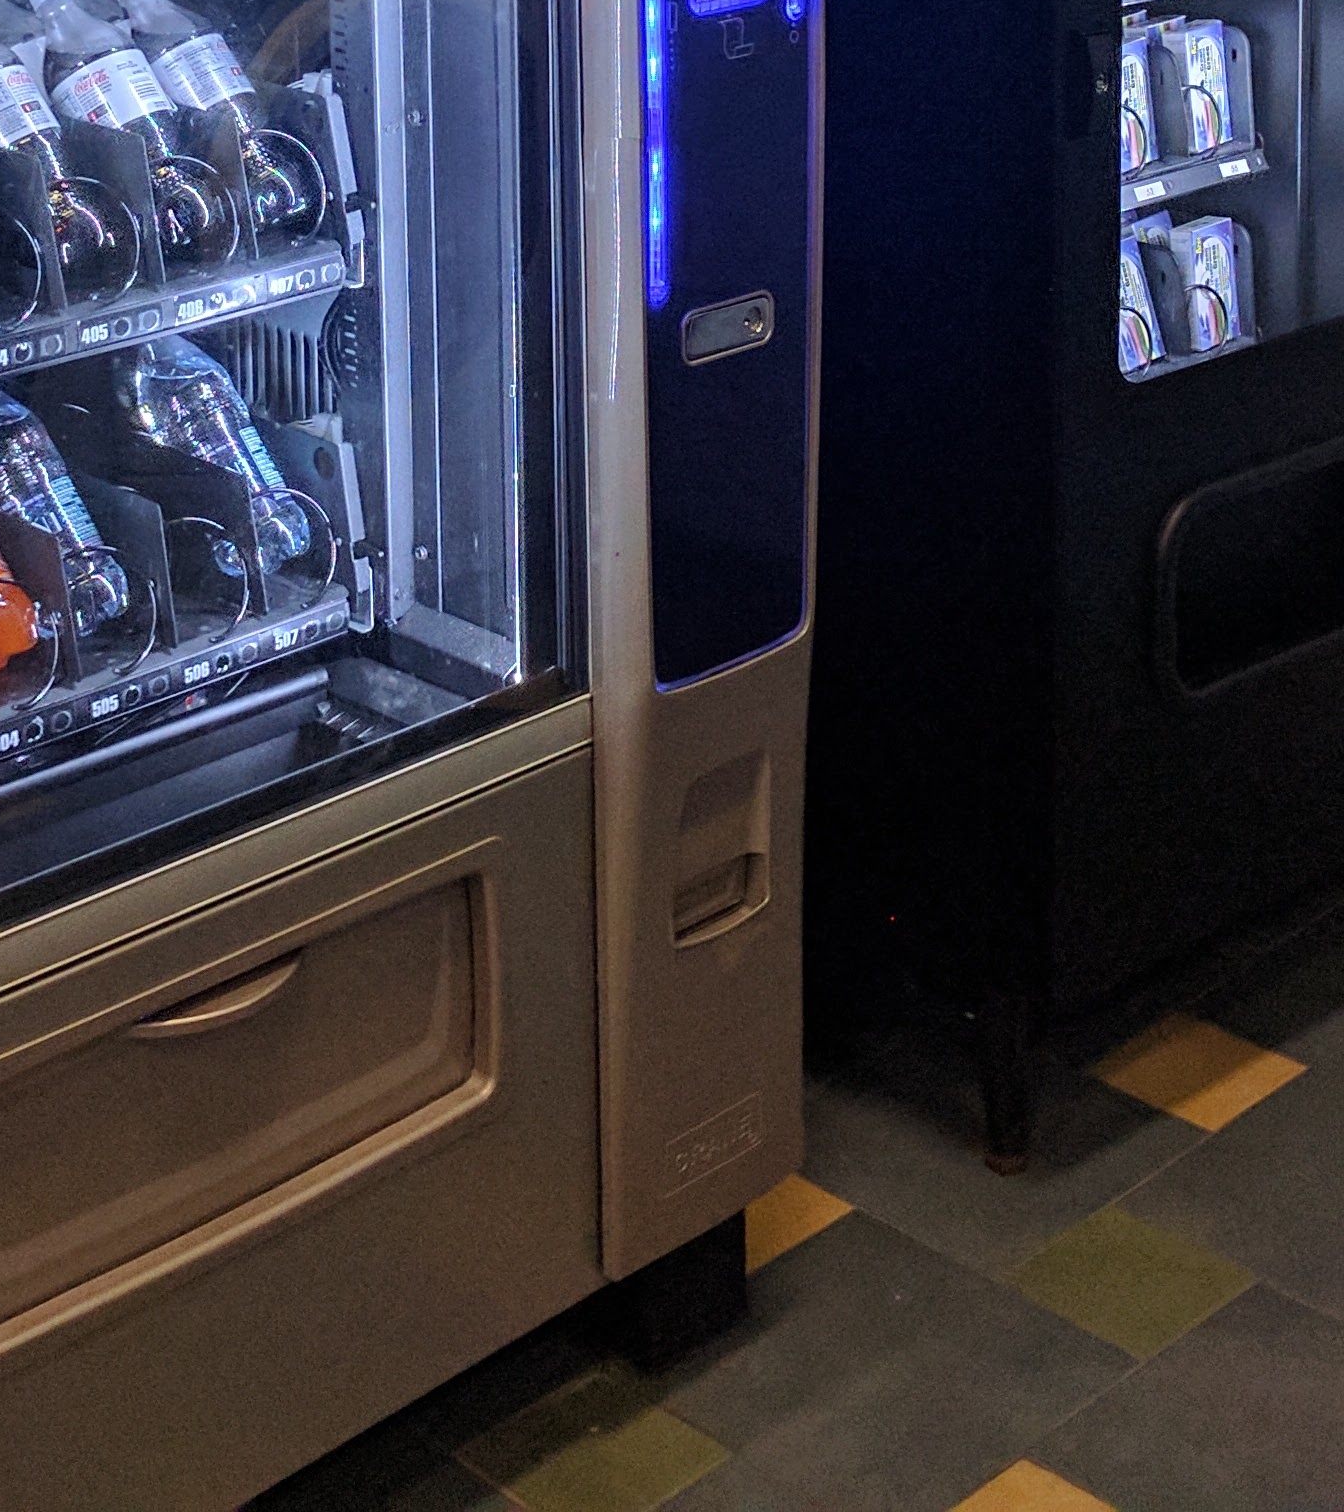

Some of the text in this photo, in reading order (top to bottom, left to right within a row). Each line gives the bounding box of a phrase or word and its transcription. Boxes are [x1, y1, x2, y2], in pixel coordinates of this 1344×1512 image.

[80, 322, 110, 343] 405
[275, 628, 299, 650] 507
[184, 661, 211, 682] 506
[92, 694, 120, 717] 505
